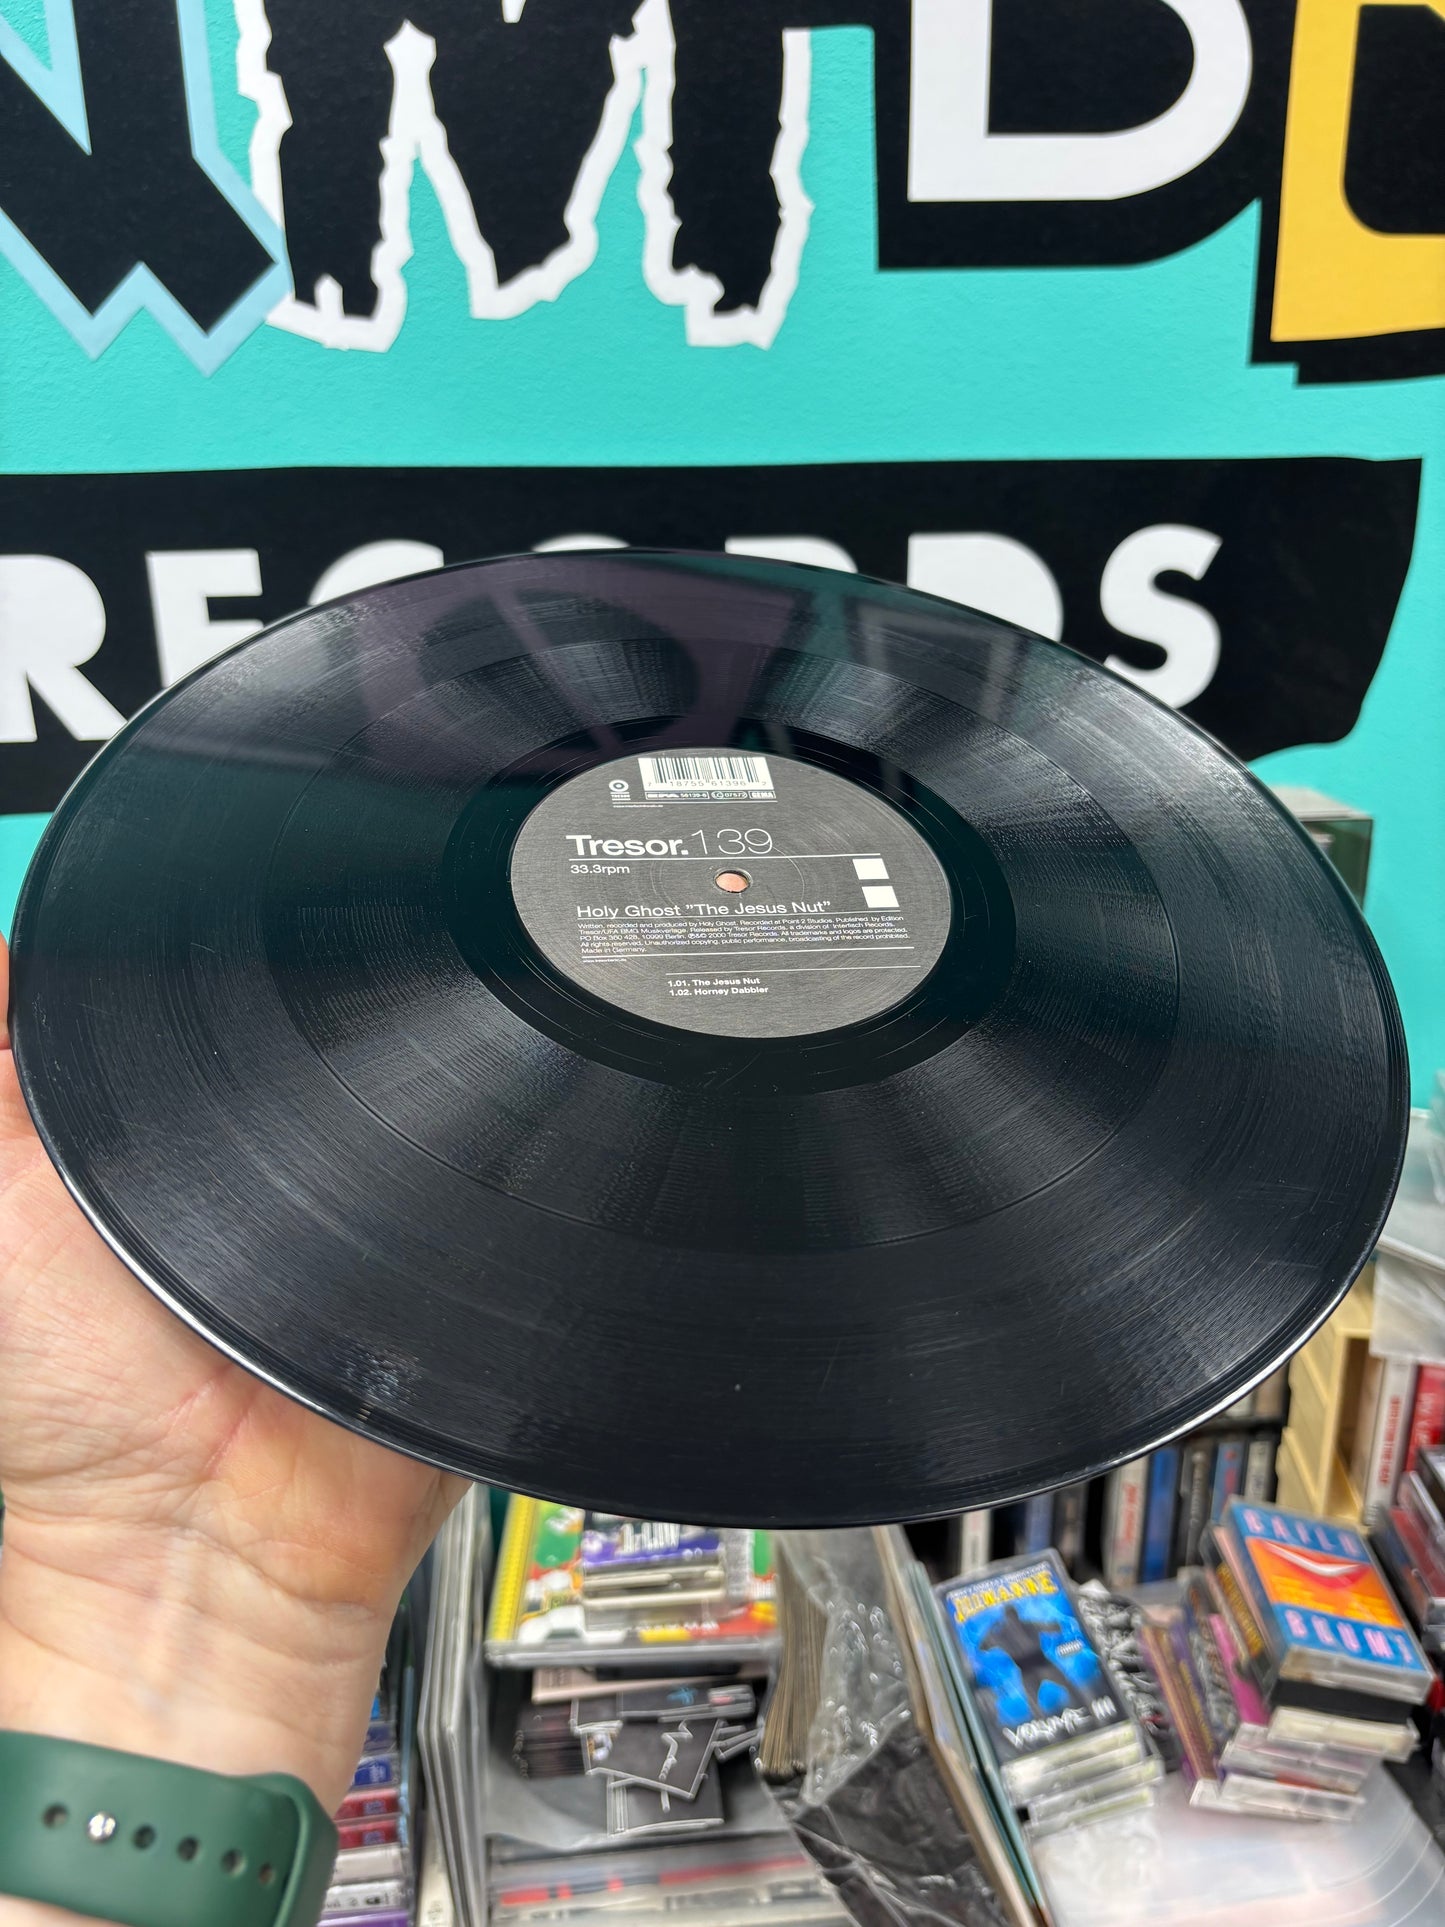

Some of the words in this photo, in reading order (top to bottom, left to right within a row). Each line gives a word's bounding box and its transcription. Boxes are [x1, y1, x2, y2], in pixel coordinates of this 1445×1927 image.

[0, 525, 1222, 742] REDS
[570, 864, 630, 876] 33.3rpm
[577, 905, 619, 920] Holy
[624, 904, 682, 916] Ghost
[734, 902, 788, 914] Jesus
